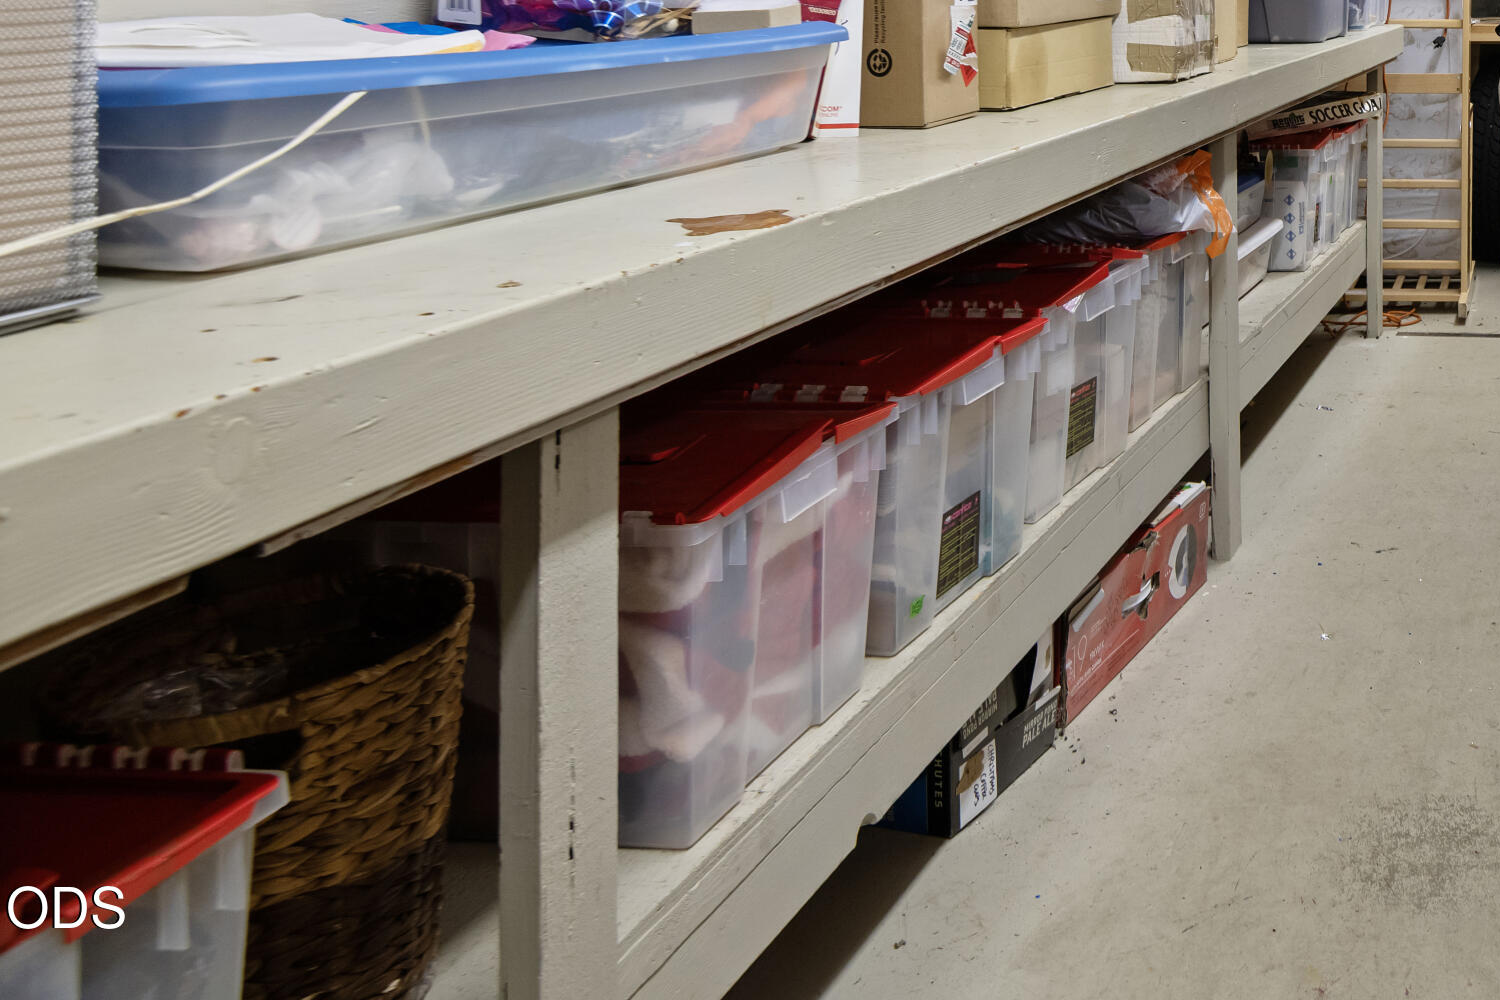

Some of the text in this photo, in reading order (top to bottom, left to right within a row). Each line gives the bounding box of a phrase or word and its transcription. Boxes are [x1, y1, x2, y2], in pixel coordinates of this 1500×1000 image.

[1309, 103, 1353, 125] SOCCER
[1022, 710, 1057, 749] PALE ALE
[934, 751, 943, 808] HUTES
